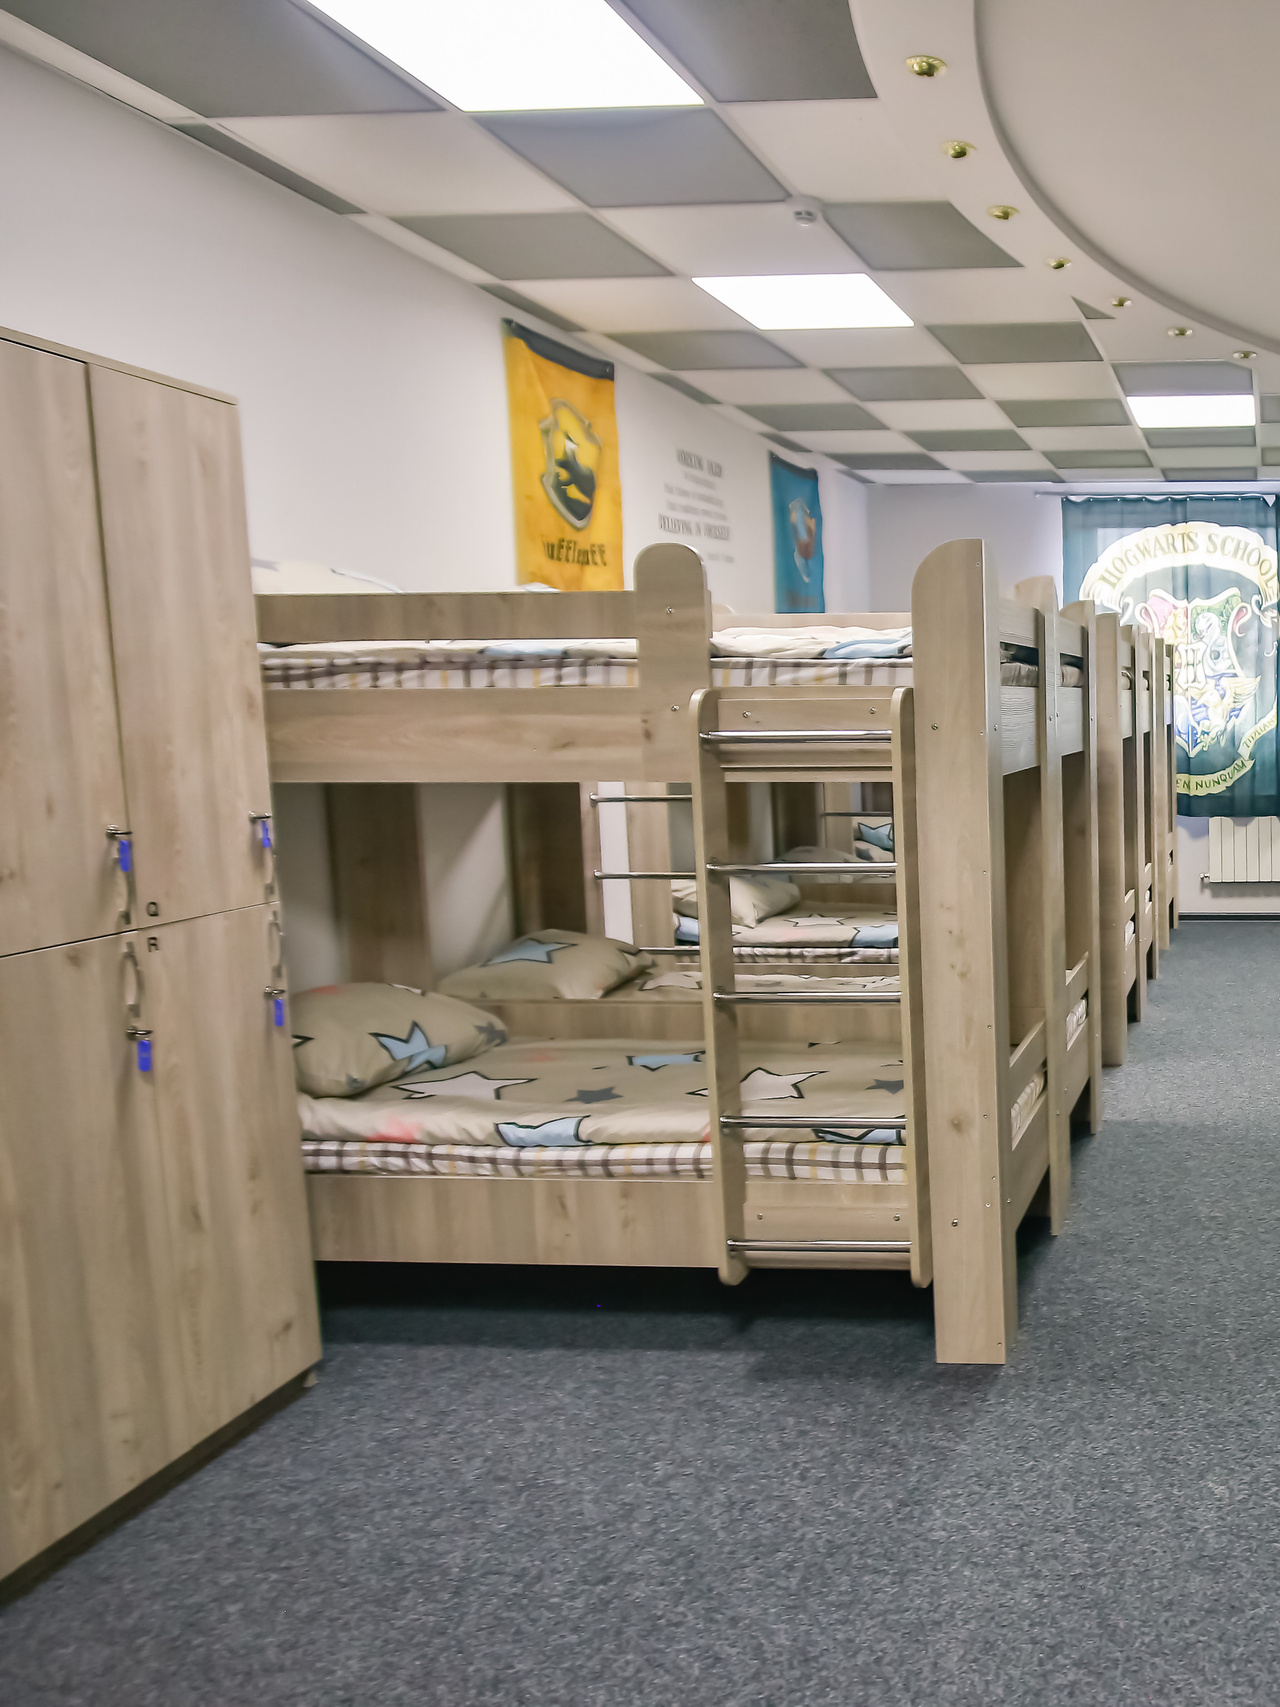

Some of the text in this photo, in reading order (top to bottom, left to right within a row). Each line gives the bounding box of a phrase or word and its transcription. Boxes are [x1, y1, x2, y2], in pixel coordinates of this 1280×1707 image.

[1097, 531, 1200, 589] HOGWARTS
[146, 901, 160, 917] Q
[147, 936, 160, 952] R
